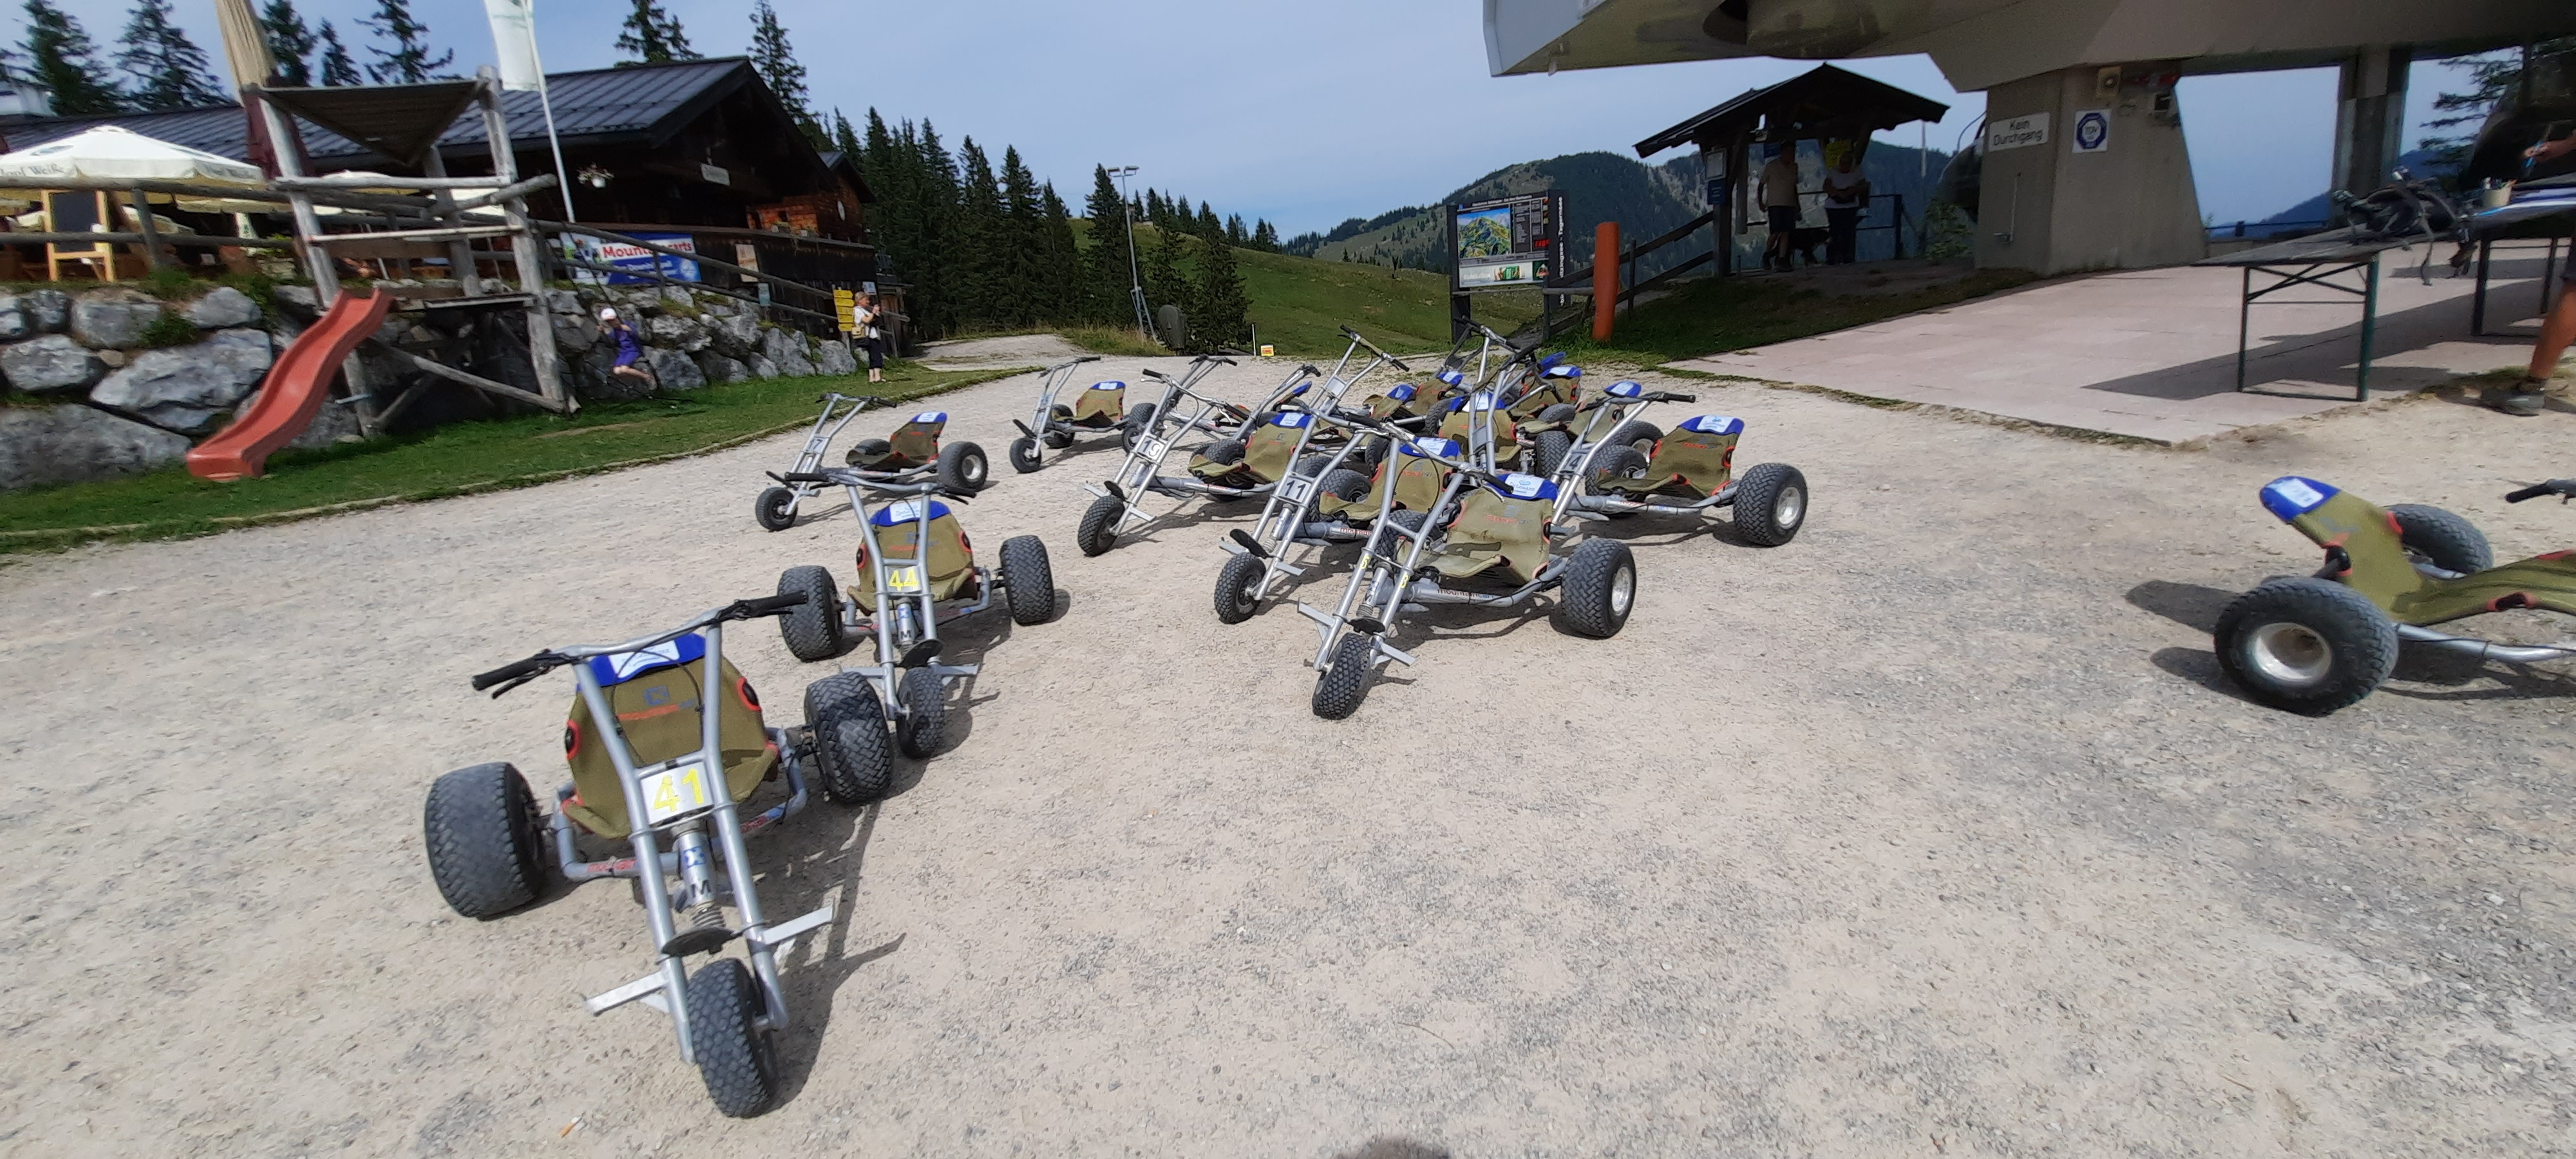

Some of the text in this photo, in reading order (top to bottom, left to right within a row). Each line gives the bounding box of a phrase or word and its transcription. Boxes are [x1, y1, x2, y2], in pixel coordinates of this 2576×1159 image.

[2009, 119, 2030, 131] Kein
[1993, 130, 2043, 146] Durchgang
[808, 438, 824, 449] 17
[1142, 439, 1161, 457] 19
[1569, 455, 1582, 470] 4
[1284, 479, 1307, 500] 11
[889, 569, 918, 592] 44
[900, 630, 912, 639] M
[652, 768, 705, 812] 41
[690, 880, 712, 899] M
